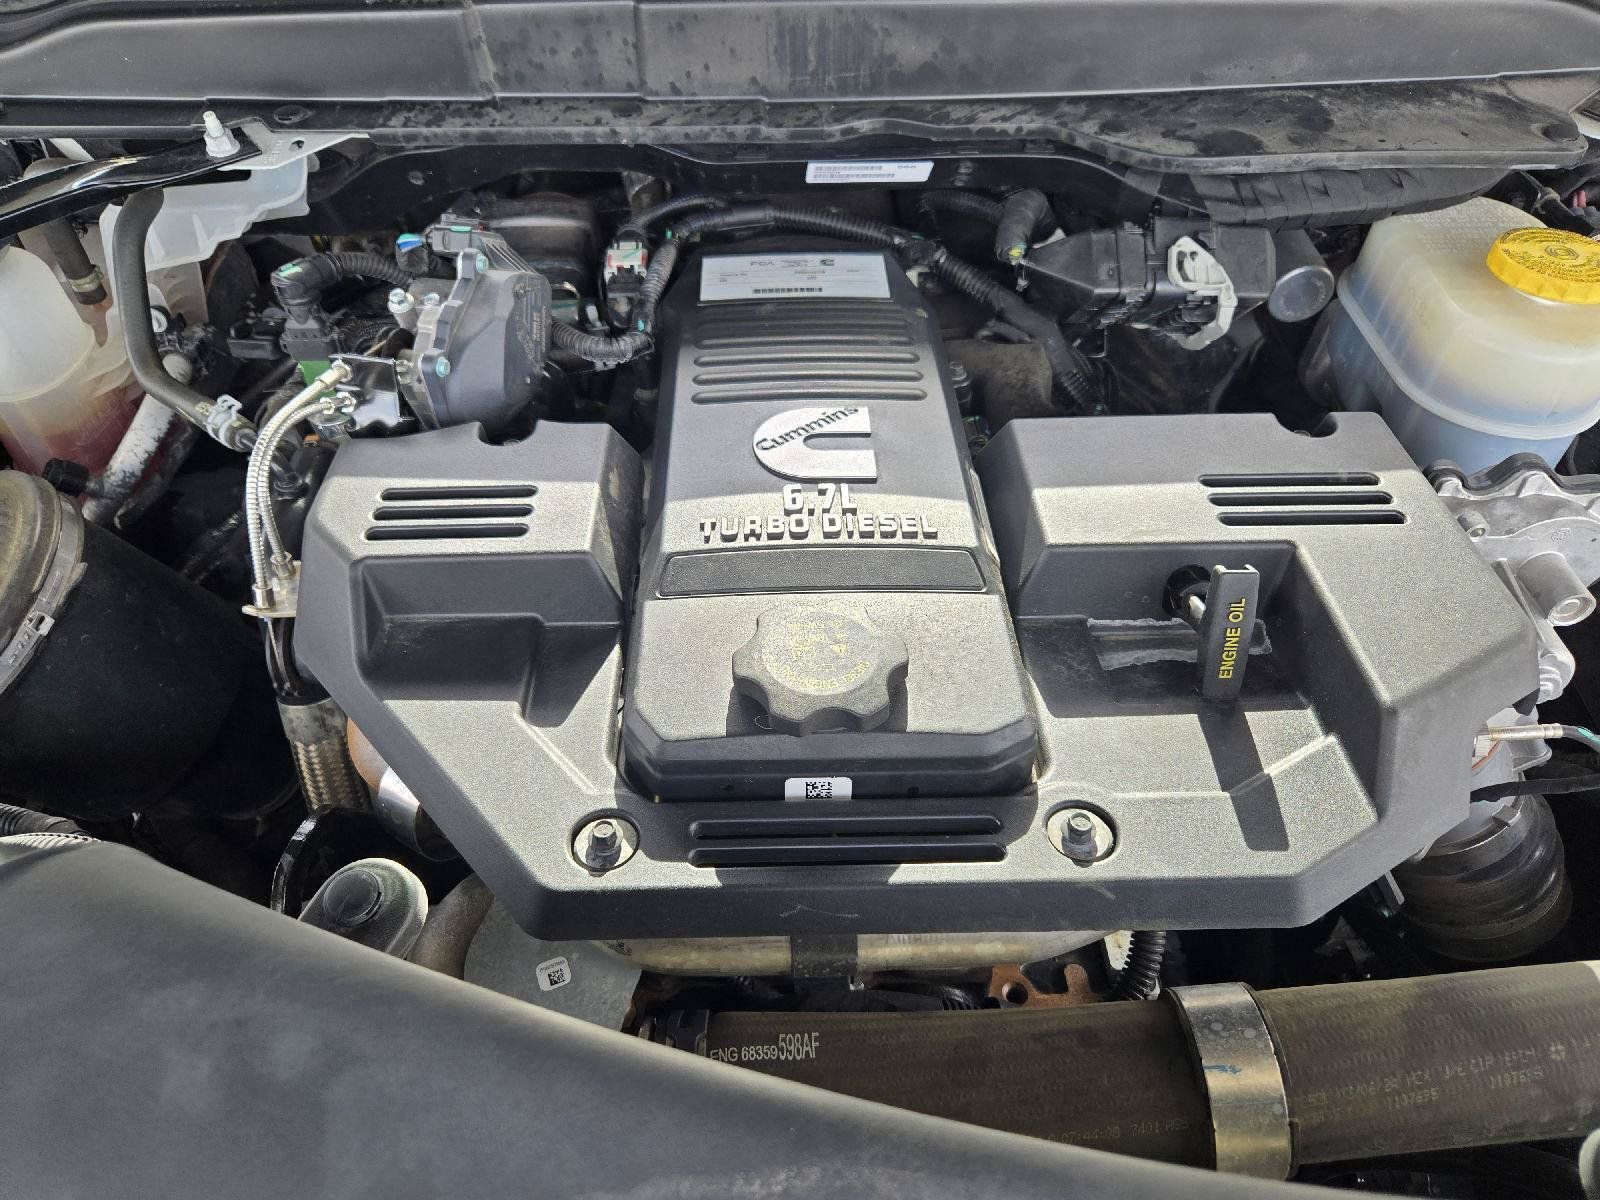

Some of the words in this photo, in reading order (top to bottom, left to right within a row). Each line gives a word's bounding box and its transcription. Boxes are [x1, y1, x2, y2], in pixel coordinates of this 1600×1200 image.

[755, 407, 859, 450] Cummins
[783, 483, 858, 513] 6.7L
[700, 513, 809, 543] TURBO
[822, 513, 938, 539] DIESEL
[1228, 598, 1246, 623] OIL
[1218, 627, 1241, 679] ENGINE
